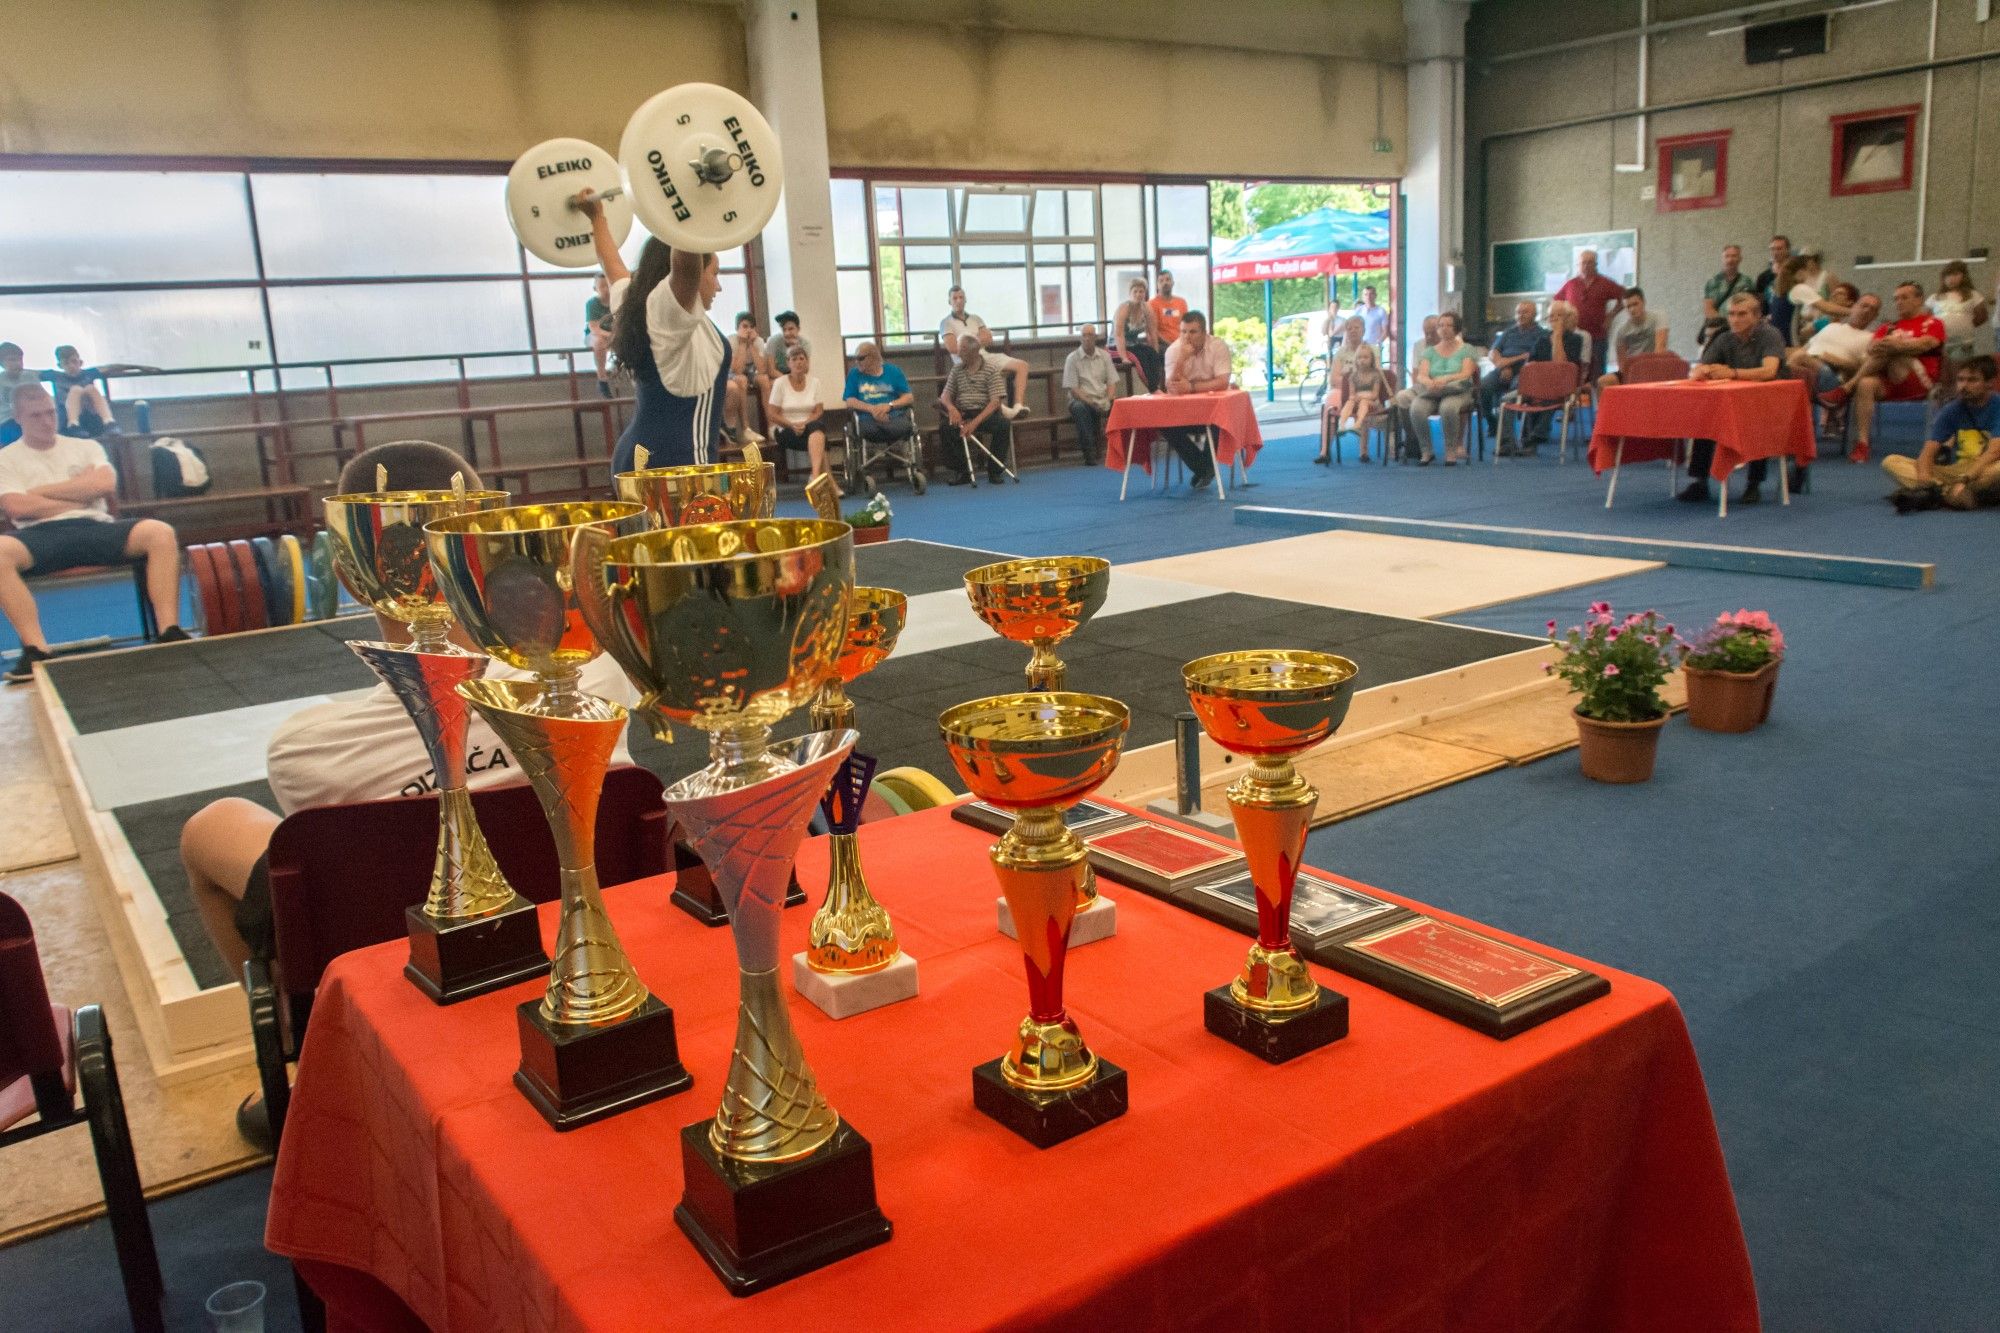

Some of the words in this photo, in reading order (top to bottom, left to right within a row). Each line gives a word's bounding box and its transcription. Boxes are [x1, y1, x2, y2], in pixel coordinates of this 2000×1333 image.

[676, 114, 691, 125] 5
[723, 116, 765, 187] ELEIKO
[536, 157, 592, 179] ELEIKO
[647, 149, 691, 222] ELEIKO
[723, 210, 738, 223] 5
[555, 231, 595, 250] EEIKO
